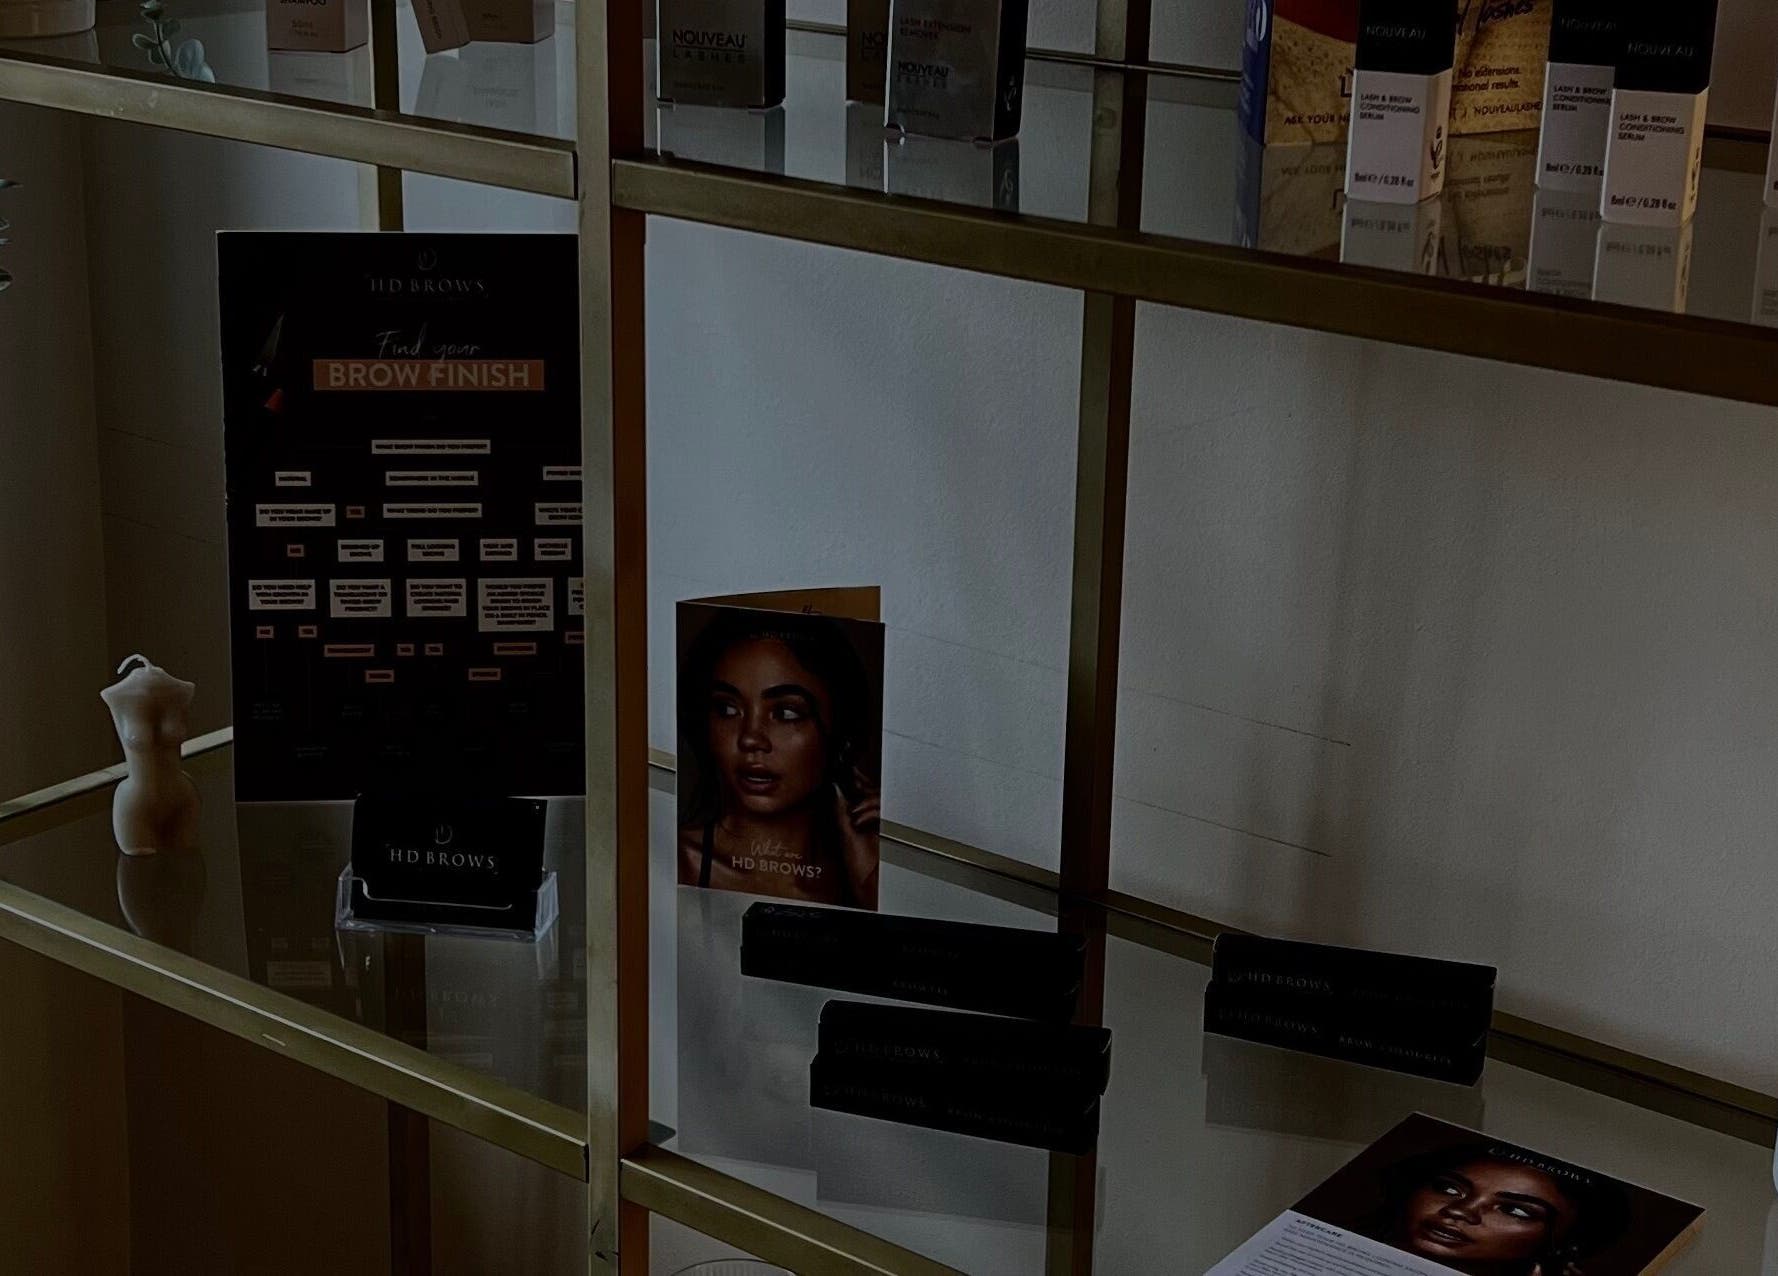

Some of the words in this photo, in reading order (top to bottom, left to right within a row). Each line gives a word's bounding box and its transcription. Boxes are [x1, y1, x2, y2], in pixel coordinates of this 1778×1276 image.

[672, 29, 746, 48] NOUVEAU
[1366, 24, 1427, 40] NOUVEAU
[898, 61, 950, 77] NOUVEAU
[1554, 86, 1573, 94] LASH
[1582, 87, 1607, 96] BROW
[1389, 95, 1413, 103] BROW
[1360, 102, 1421, 115] CONDITIONING
[1284, 114, 1303, 125] ASK
[1307, 113, 1335, 124] YOUR
[1360, 112, 1384, 120] SERUM
[1620, 113, 1641, 121] LASH
[1651, 116, 1677, 124] BROW
[1619, 123, 1685, 135] CONDITIONING
[1617, 132, 1645, 141] SERUM
[370, 279, 403, 293] HD
[409, 278, 486, 294] BROWS
[375, 320, 430, 360] Find
[328, 363, 421, 387] BROW
[430, 363, 530, 387] FINISH
[390, 848, 420, 864] HD
[427, 850, 496, 870] BROWS
[731, 855, 755, 870] HD
[759, 860, 823, 878] BROWS?
